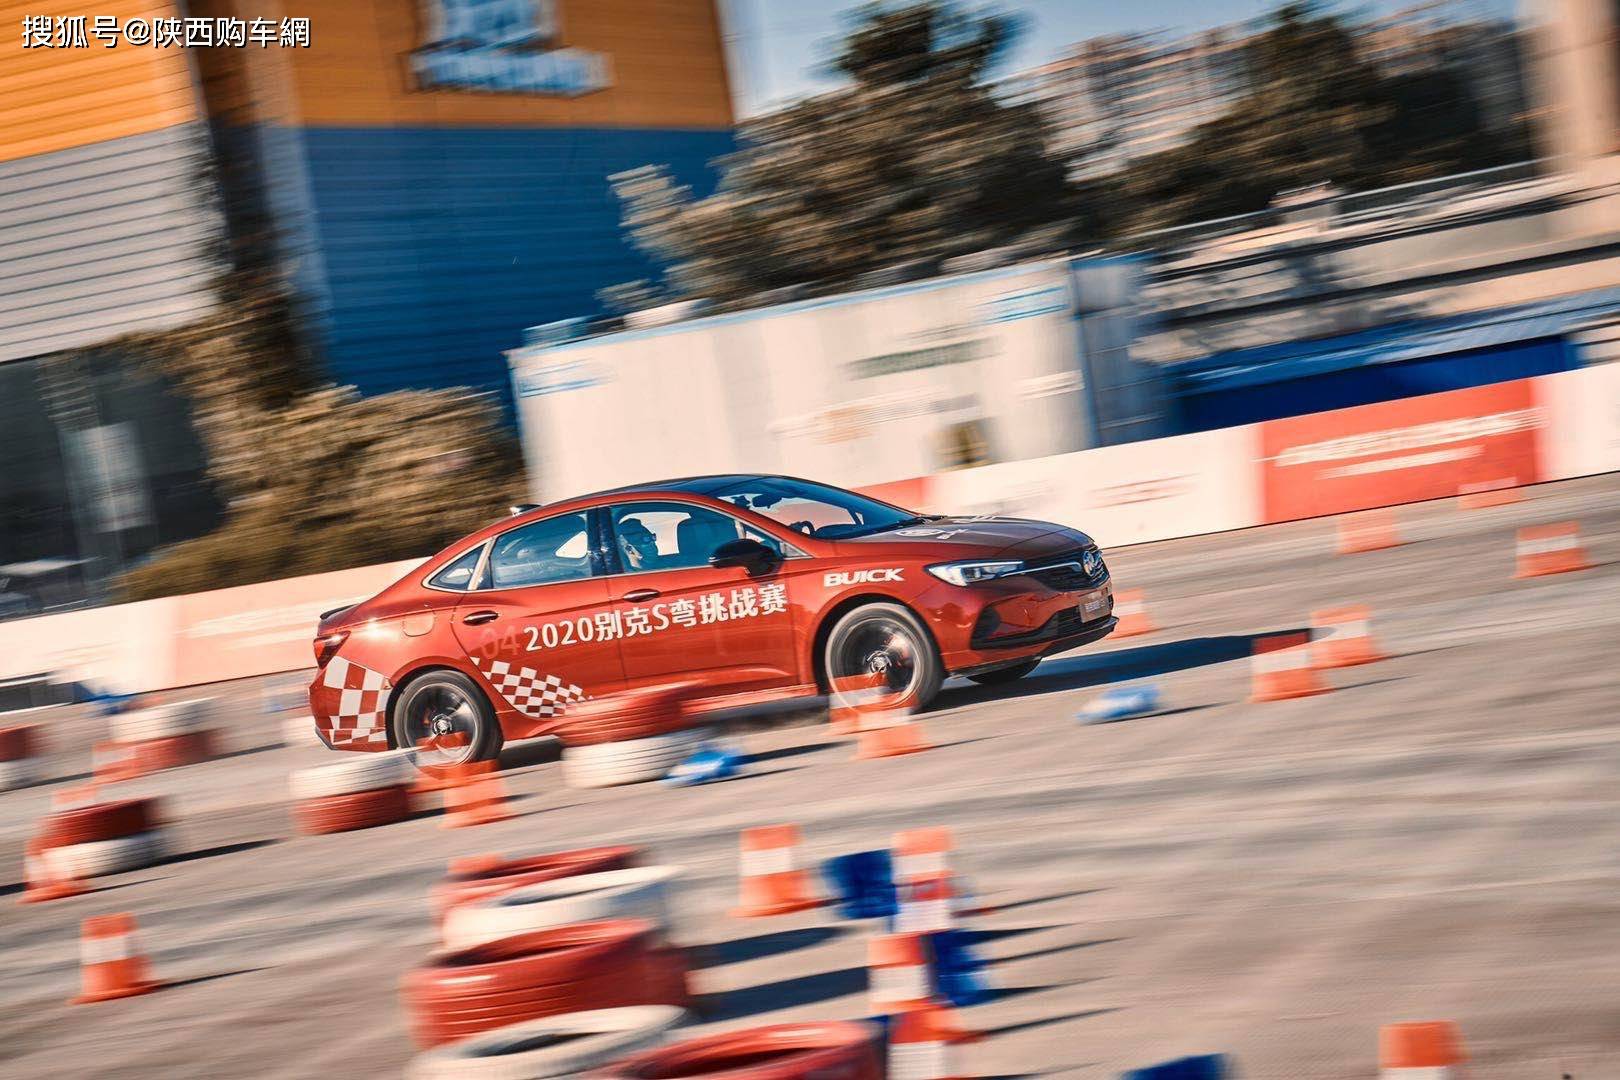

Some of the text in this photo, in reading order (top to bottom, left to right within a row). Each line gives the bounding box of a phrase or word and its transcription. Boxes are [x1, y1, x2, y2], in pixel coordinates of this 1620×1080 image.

[823, 568, 905, 587] BUICK
[523, 583, 787, 651] 2020别克S弯挑战赛
